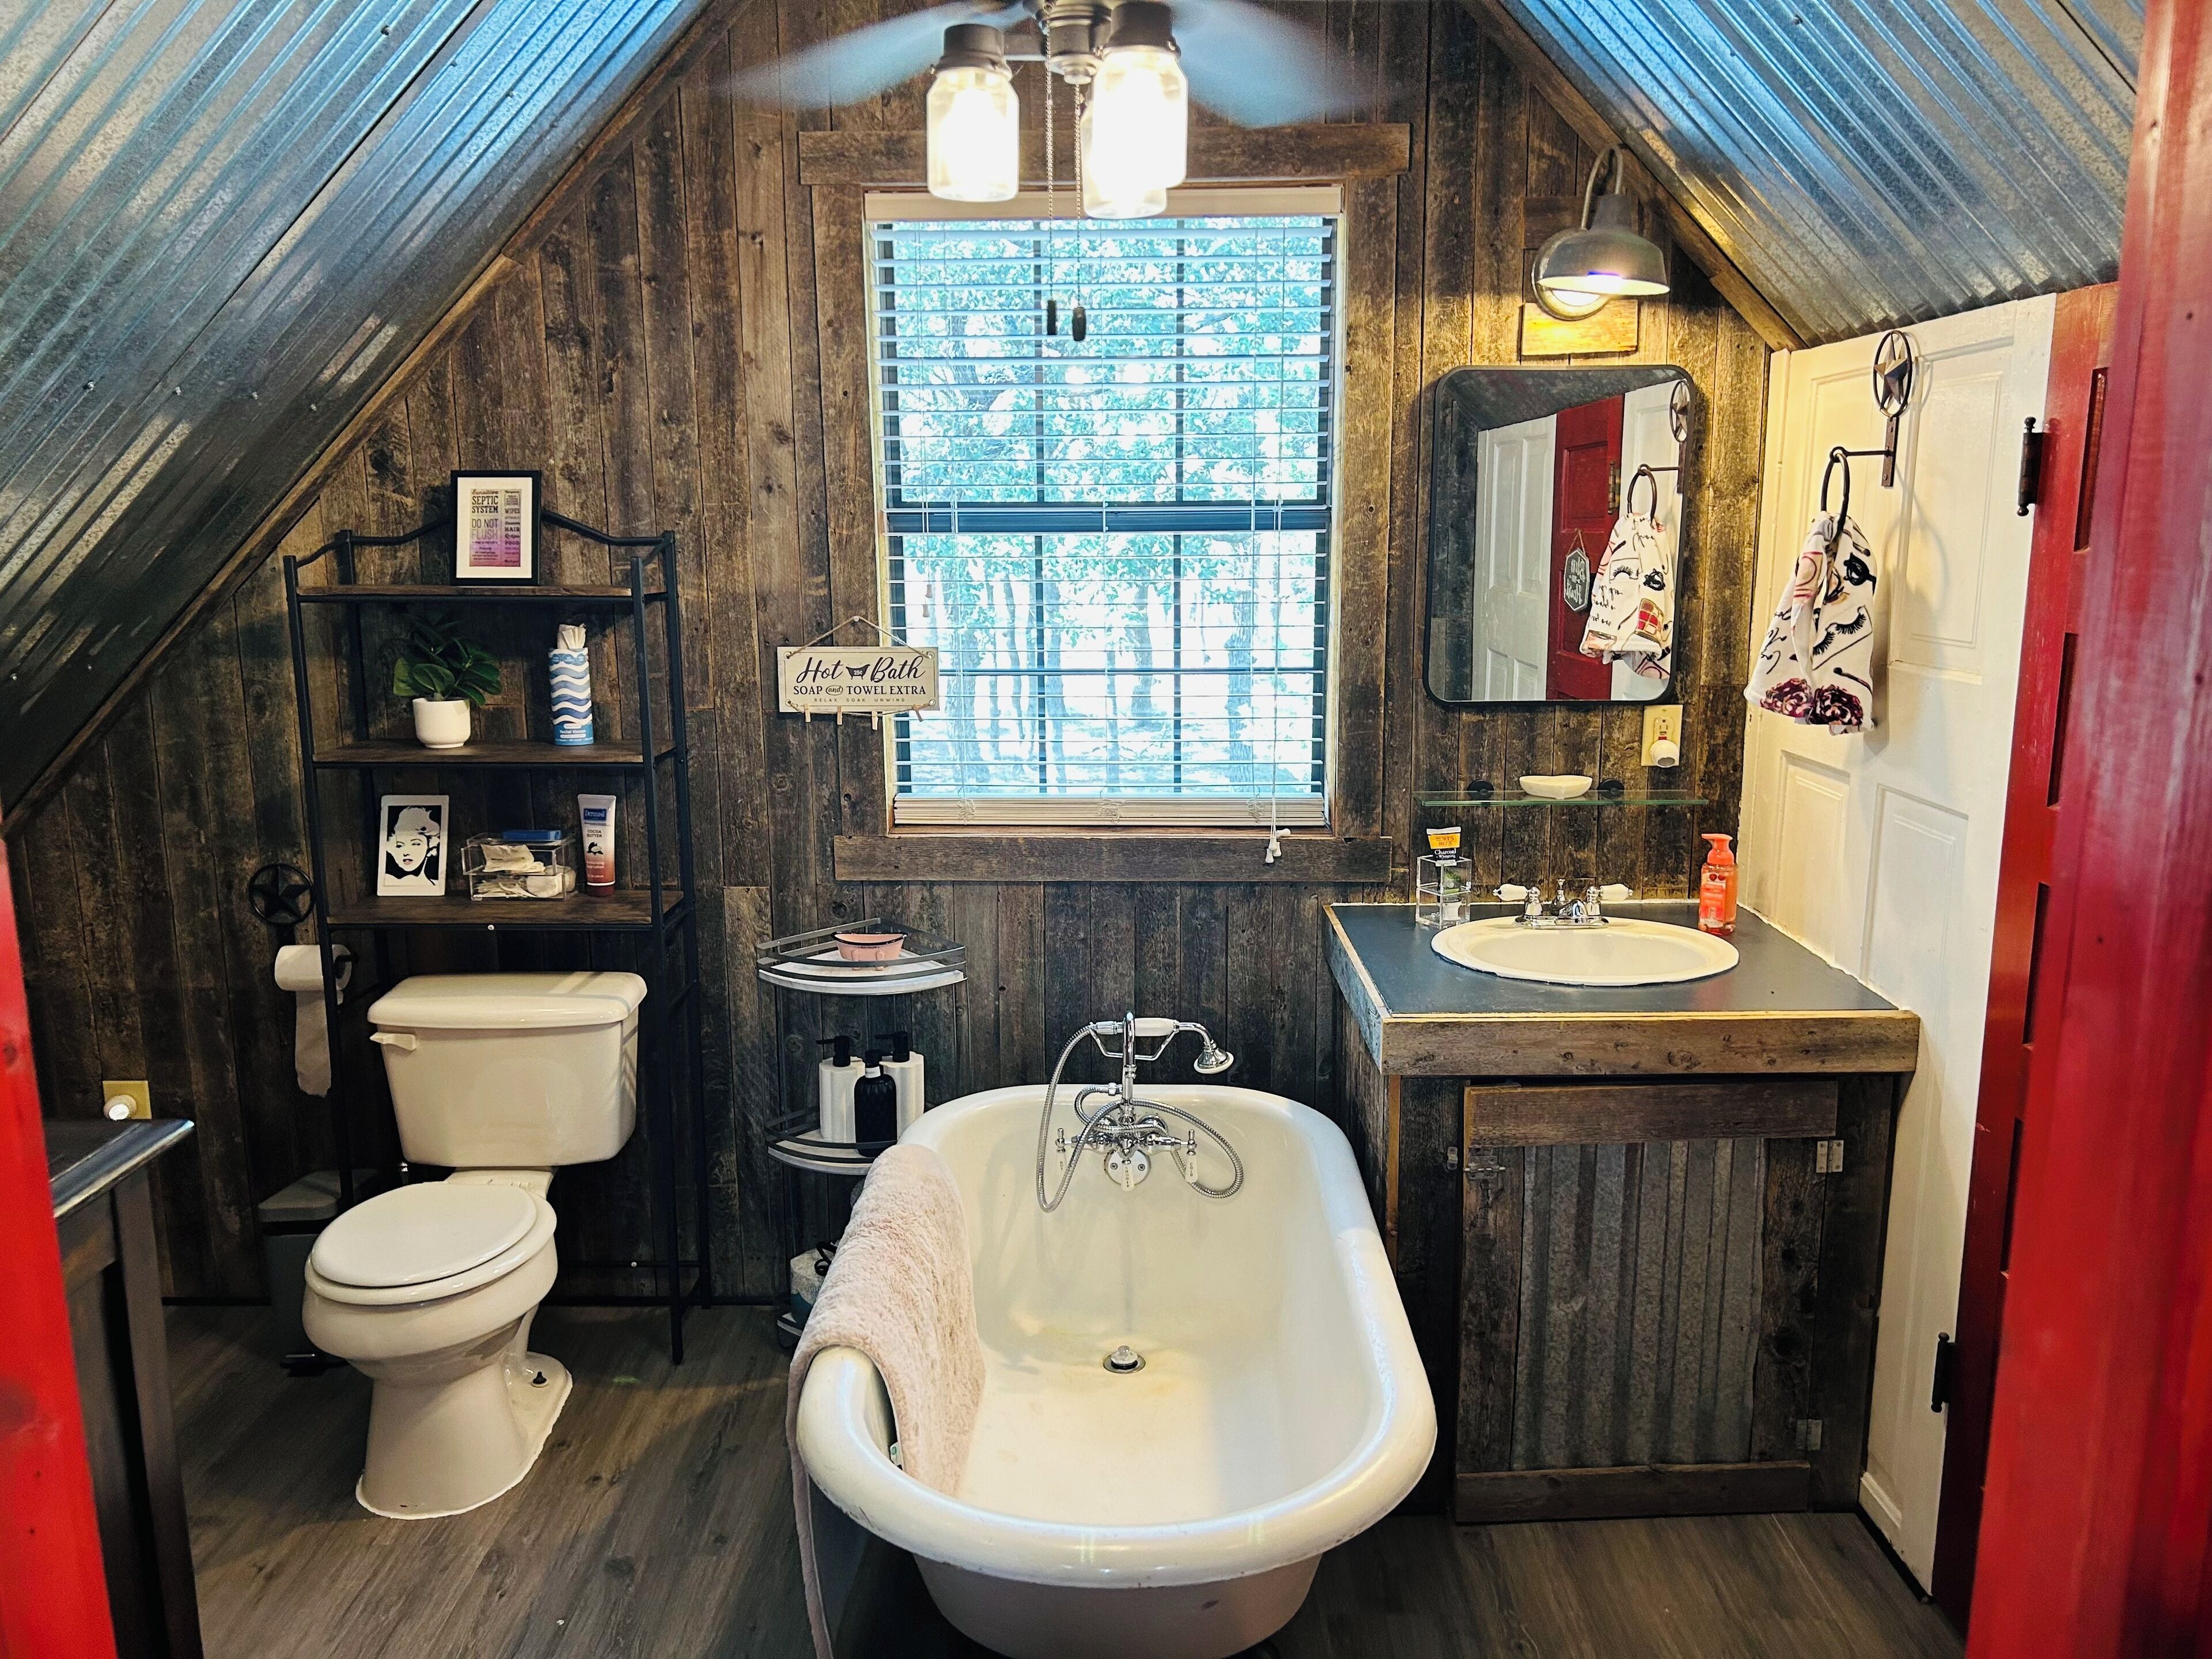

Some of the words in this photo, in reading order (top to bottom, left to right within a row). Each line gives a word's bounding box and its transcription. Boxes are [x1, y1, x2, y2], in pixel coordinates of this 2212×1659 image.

[472, 495, 499, 505] SEPTIC
[471, 518, 482, 528] DO
[484, 518, 499, 528] NOT
[471, 529, 498, 540] FLUSH
[796, 657, 844, 683] Hot
[870, 656, 926, 683] Bath
[793, 685, 823, 695] SOAP
[827, 685, 843, 695] and
[846, 685, 887, 695] TOWEL
[889, 685, 926, 695] EXTRA
